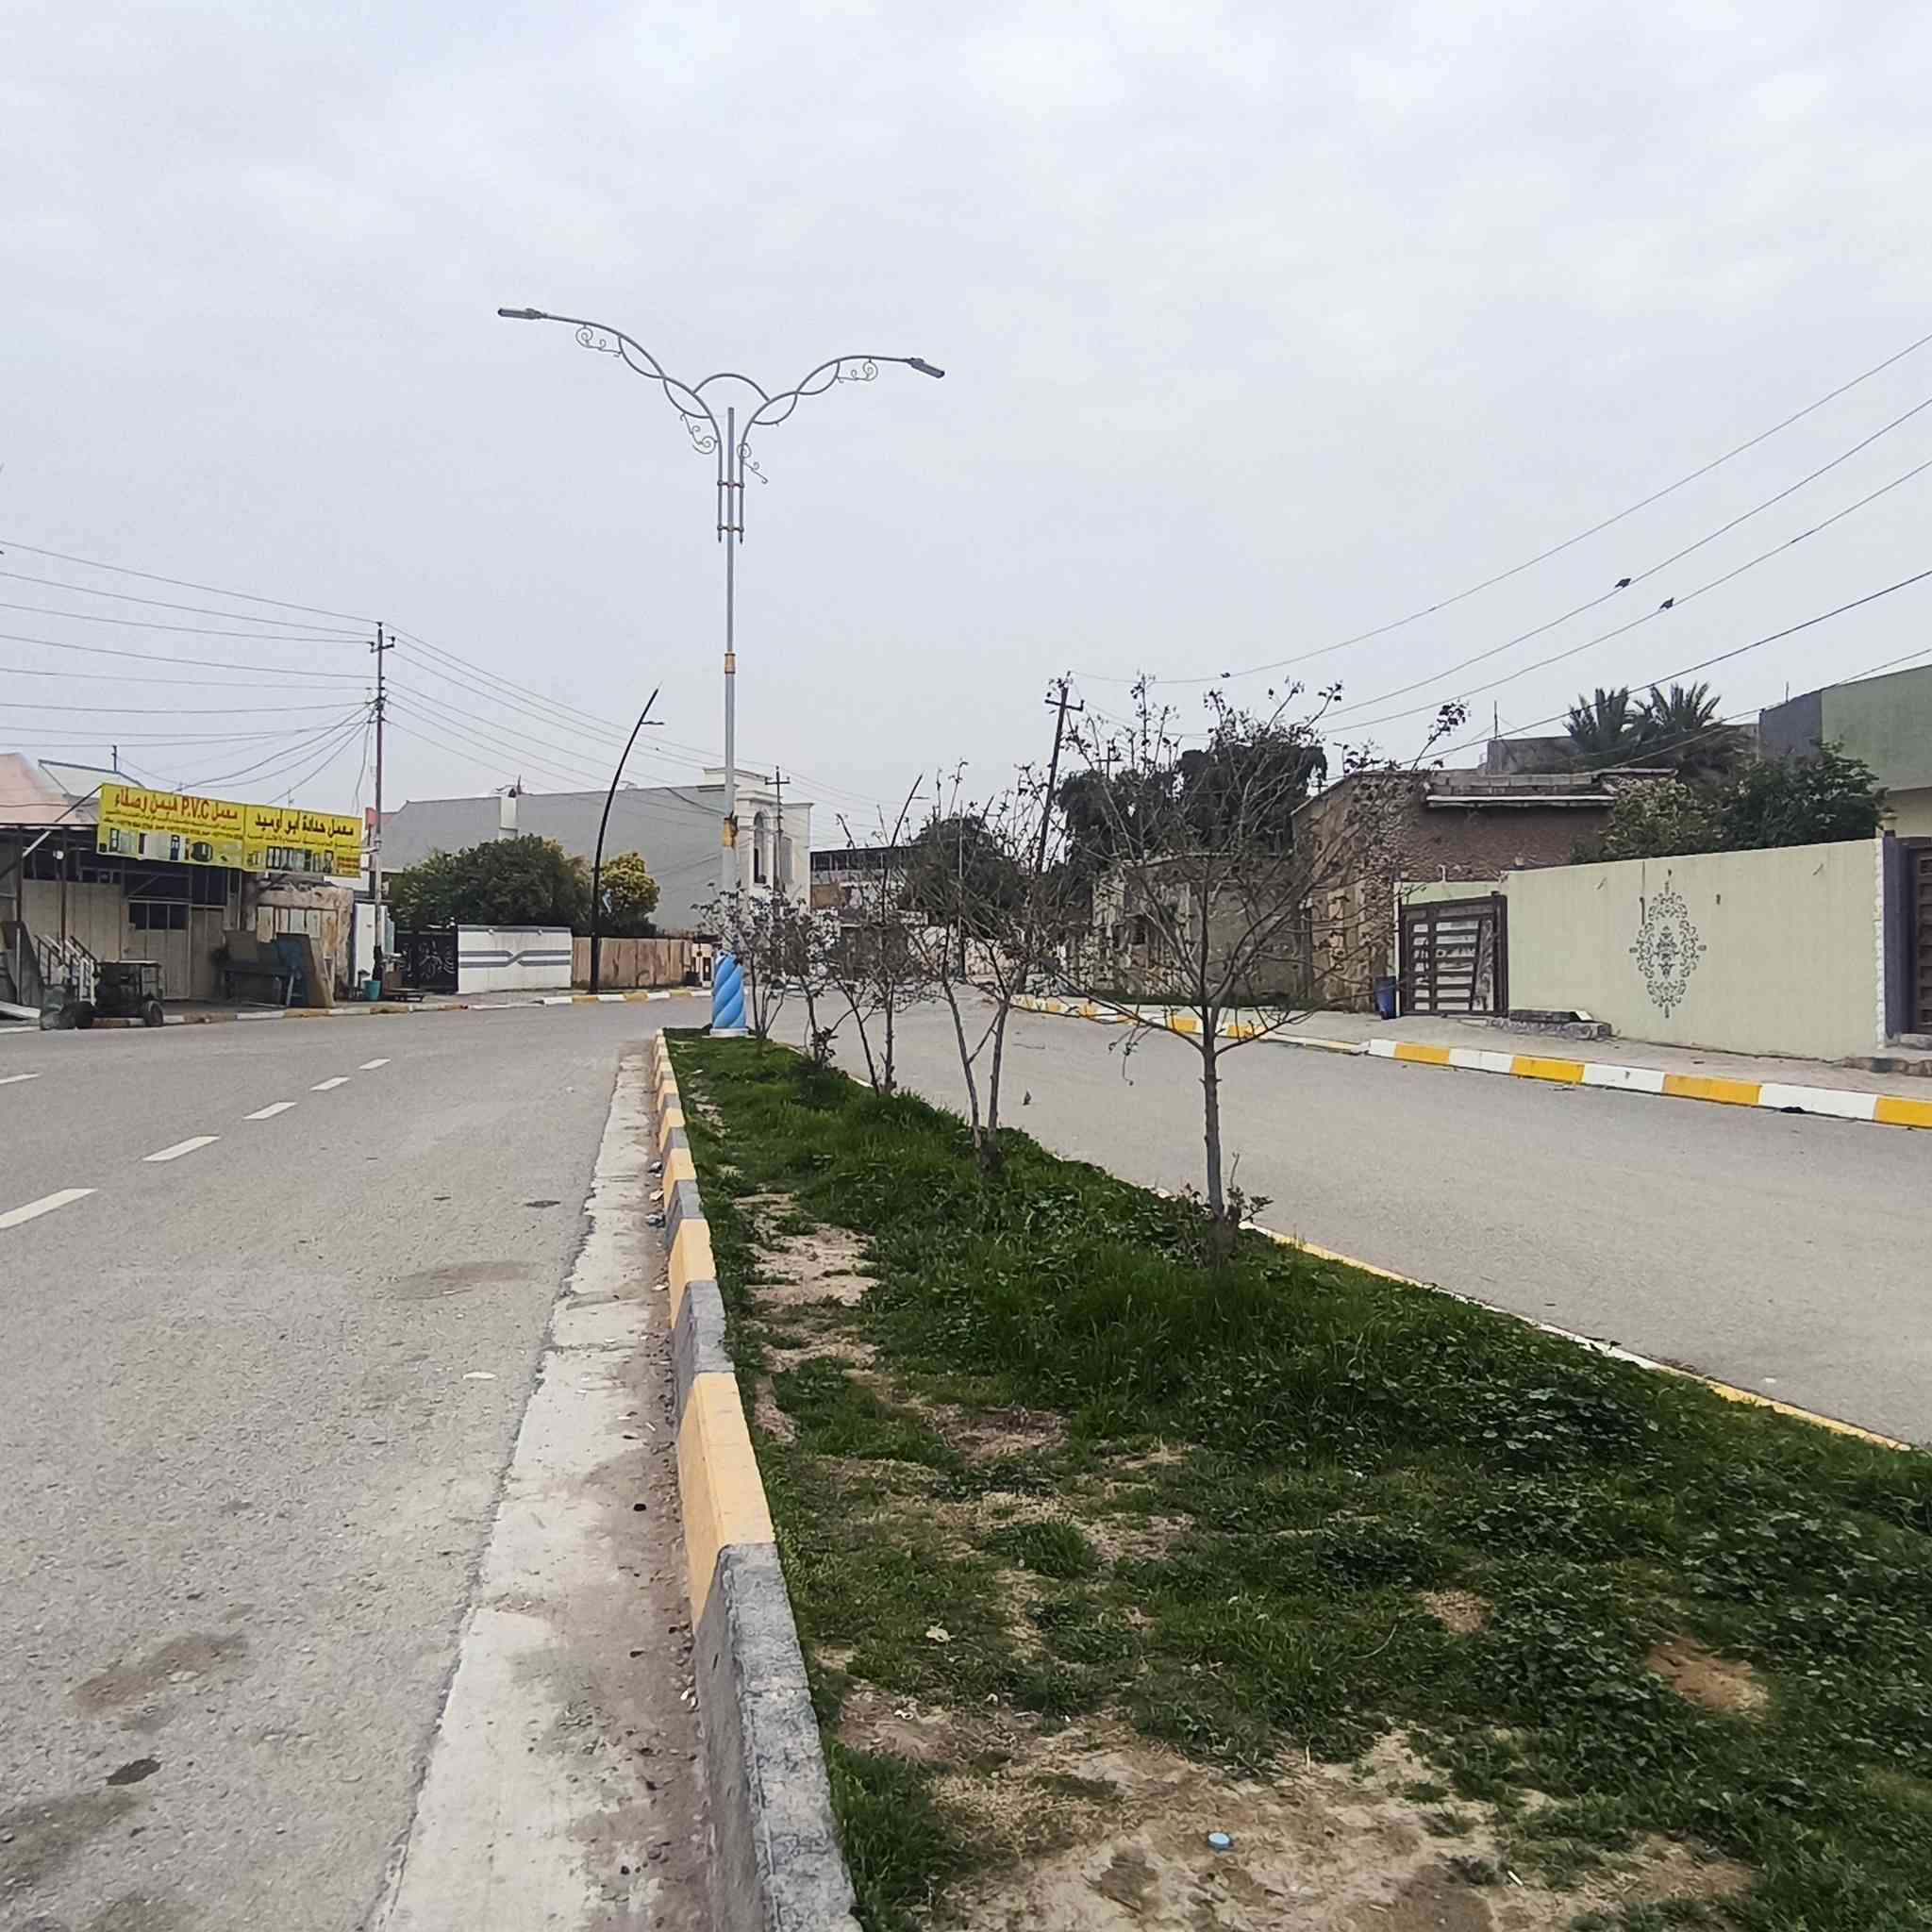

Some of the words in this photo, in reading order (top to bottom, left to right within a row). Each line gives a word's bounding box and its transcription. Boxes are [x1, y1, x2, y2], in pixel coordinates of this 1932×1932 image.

[181, 796, 209, 819] P.V.C
[211, 801, 238, 822] معمل
[327, 818, 354, 838] معمل
